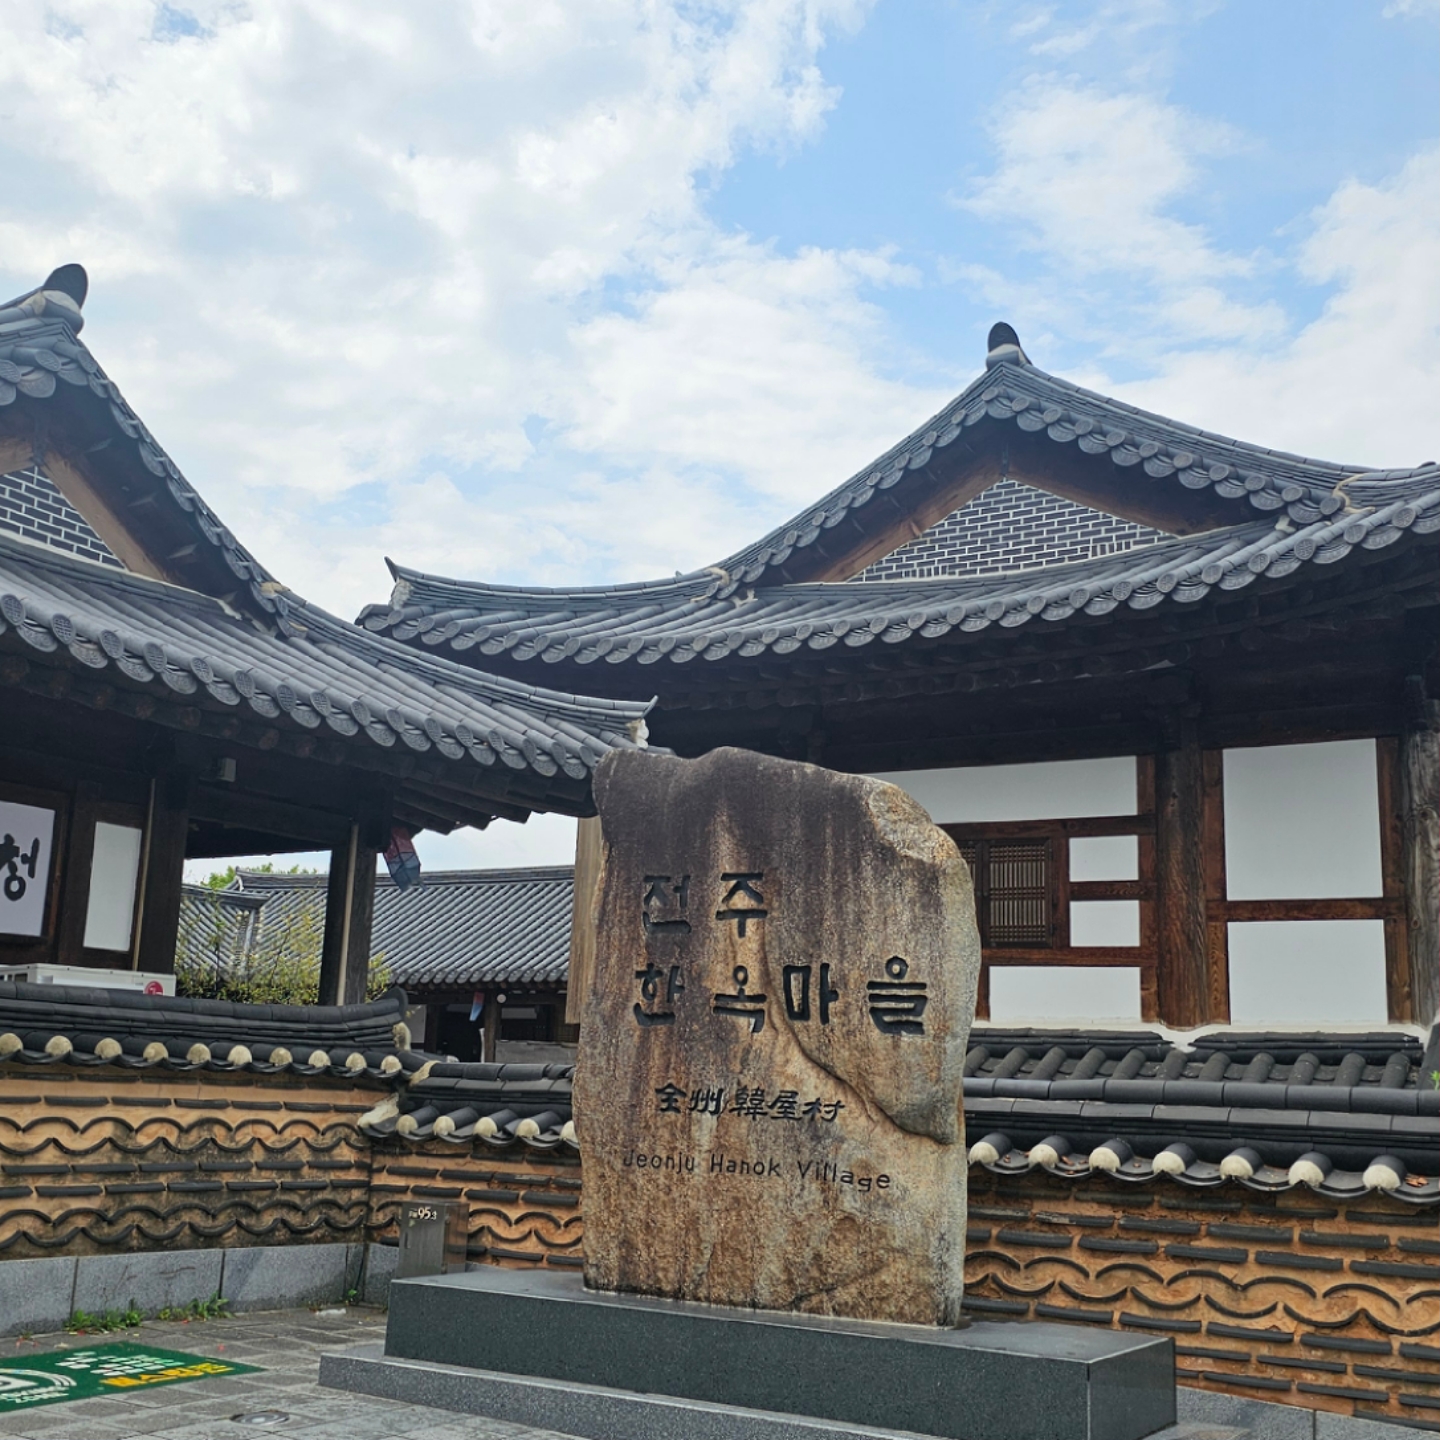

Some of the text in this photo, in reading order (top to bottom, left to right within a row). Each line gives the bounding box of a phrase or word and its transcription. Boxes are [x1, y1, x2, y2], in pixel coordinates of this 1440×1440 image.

[0, 832, 40, 901] 청
[643, 874, 768, 939] 전주
[635, 956, 930, 1036] 한옥마을
[622, 1150, 892, 1193] Jeonju Hanok Village
